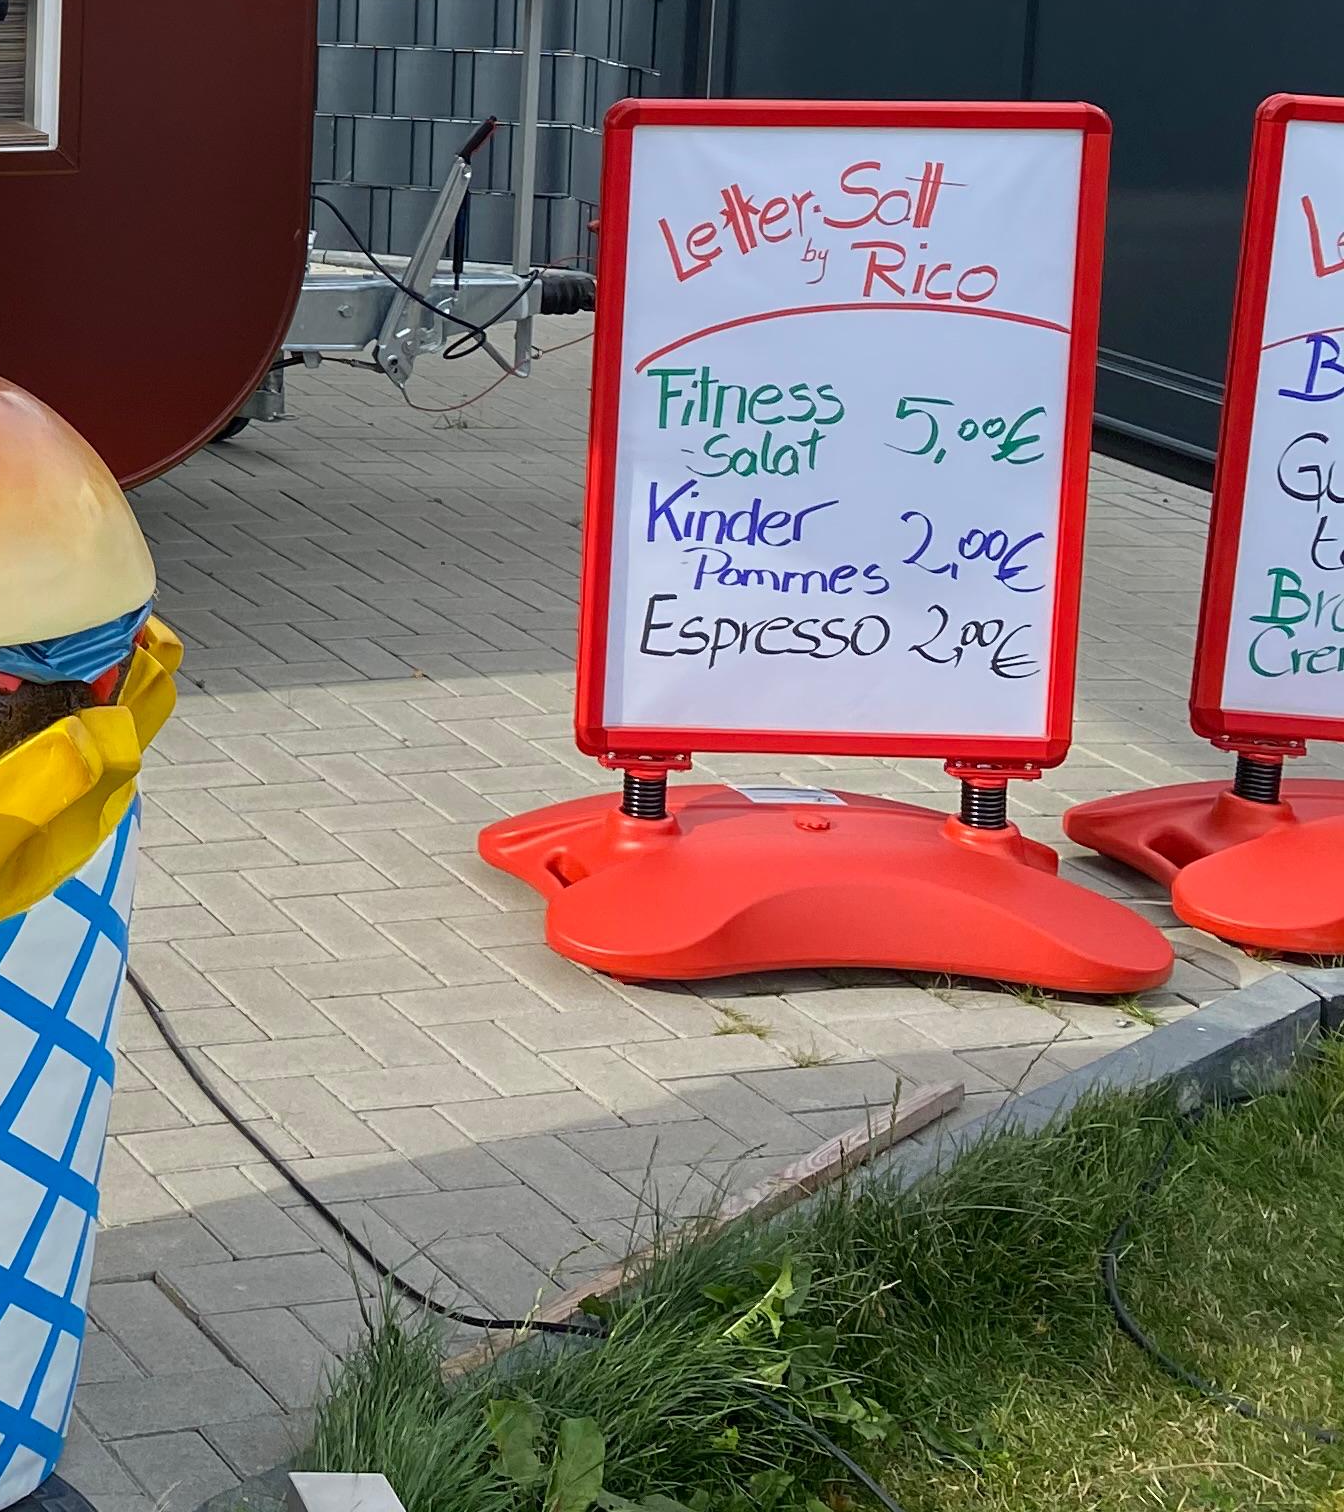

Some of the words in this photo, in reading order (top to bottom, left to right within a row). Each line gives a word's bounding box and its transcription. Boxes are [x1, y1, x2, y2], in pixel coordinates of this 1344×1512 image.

[800, 237, 829, 284] by
[850, 240, 999, 302] Rico
[647, 366, 845, 429] Fitness
[884, 396, 1047, 464] 5,00€
[646, 479, 839, 546] Kinder
[900, 511, 1046, 592] 2,00€
[640, 593, 891, 670] Espresso
[909, 604, 1041, 679] 2,00€
